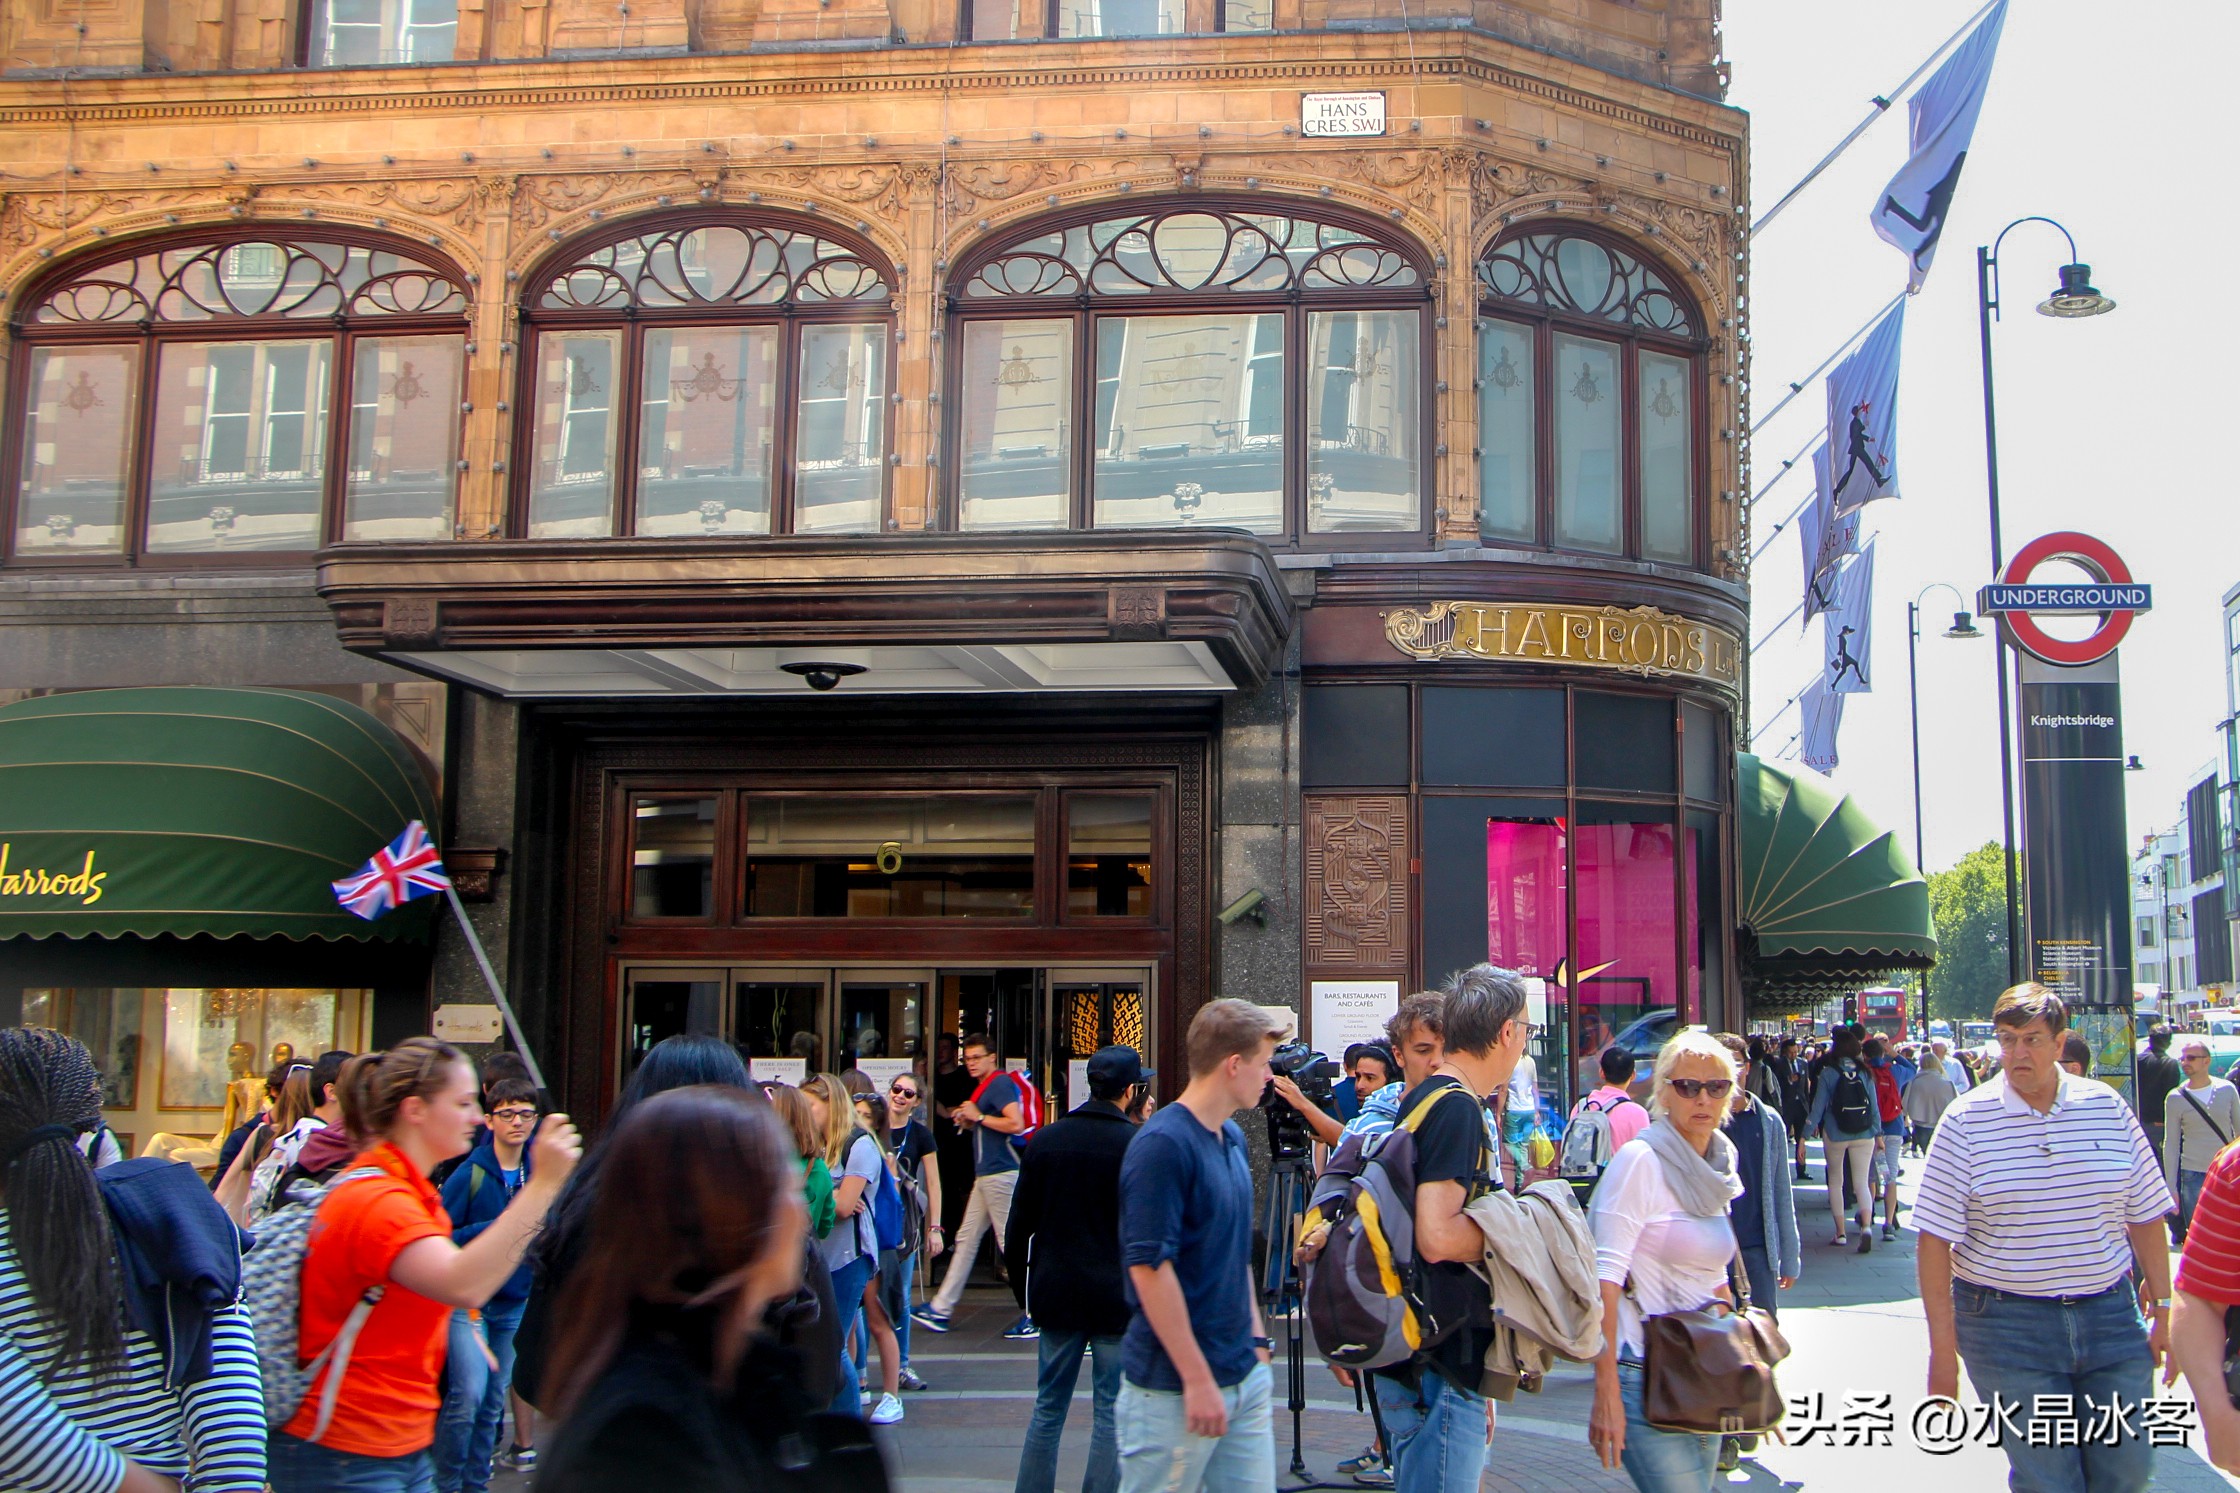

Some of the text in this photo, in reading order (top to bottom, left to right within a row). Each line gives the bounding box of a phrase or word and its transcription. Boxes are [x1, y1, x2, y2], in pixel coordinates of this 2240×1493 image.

[1320, 103, 1367, 117] HANS
[1304, 119, 1350, 133] CRES.
[1992, 589, 2146, 605] UNDERGROUND
[1466, 609, 1706, 673] HARRODS
[2030, 715, 2115, 728] Knightsbridge
[1803, 755, 1837, 766] SALE
[876, 841, 902, 875] 6
